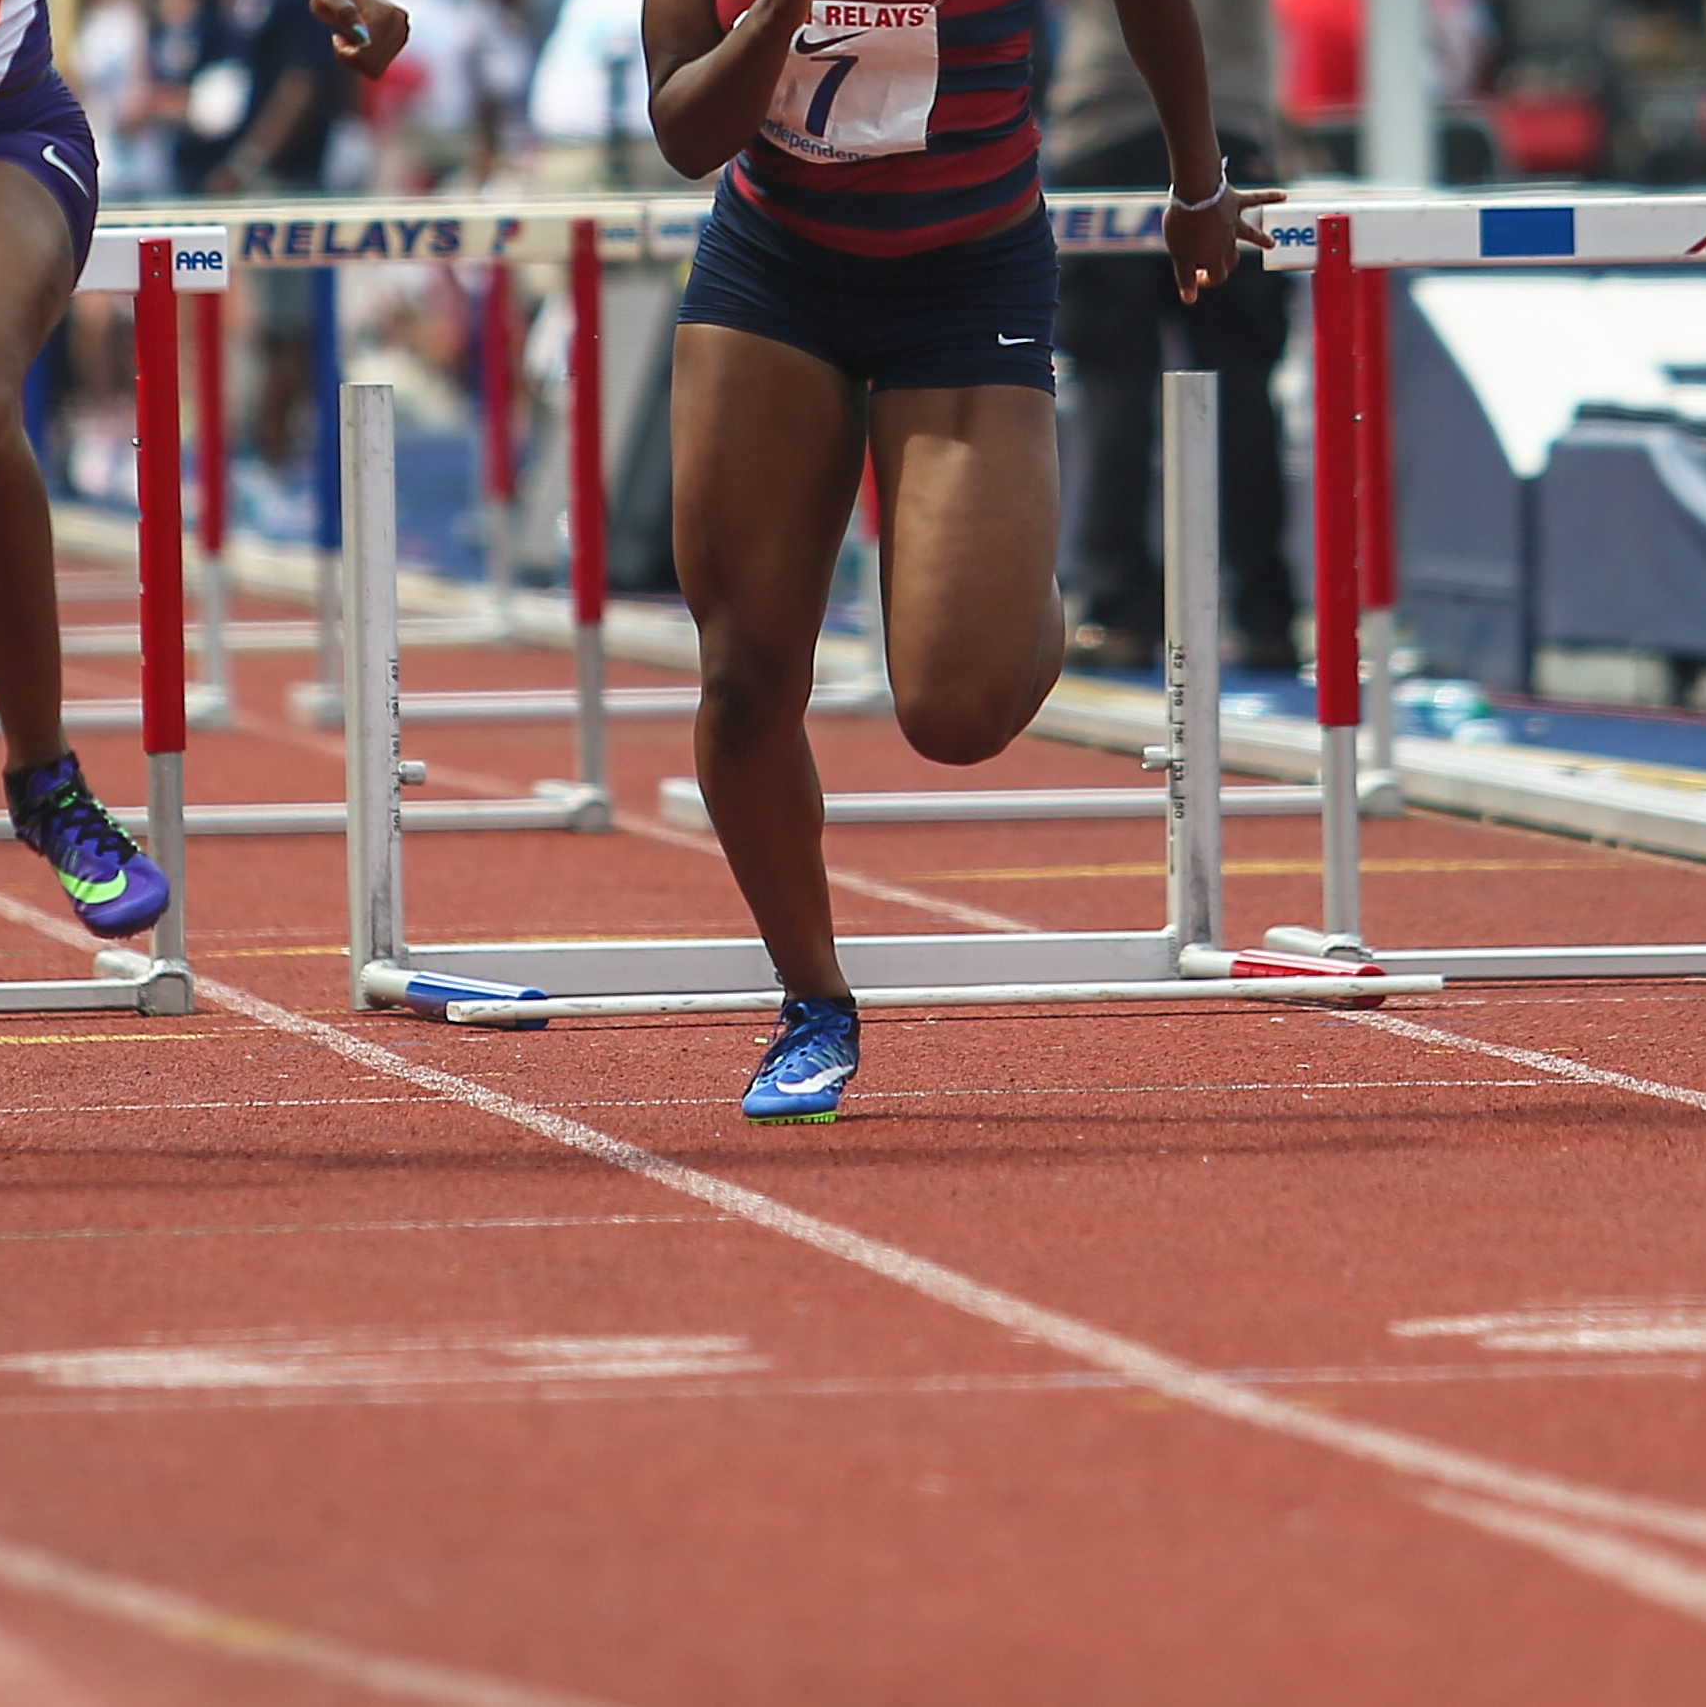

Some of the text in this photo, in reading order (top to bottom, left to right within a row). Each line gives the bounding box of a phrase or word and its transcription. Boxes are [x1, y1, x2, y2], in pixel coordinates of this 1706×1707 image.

[825, 5, 925, 28] RELAYS
[809, 54, 860, 138] 7
[240, 219, 463, 261] RELAYS
